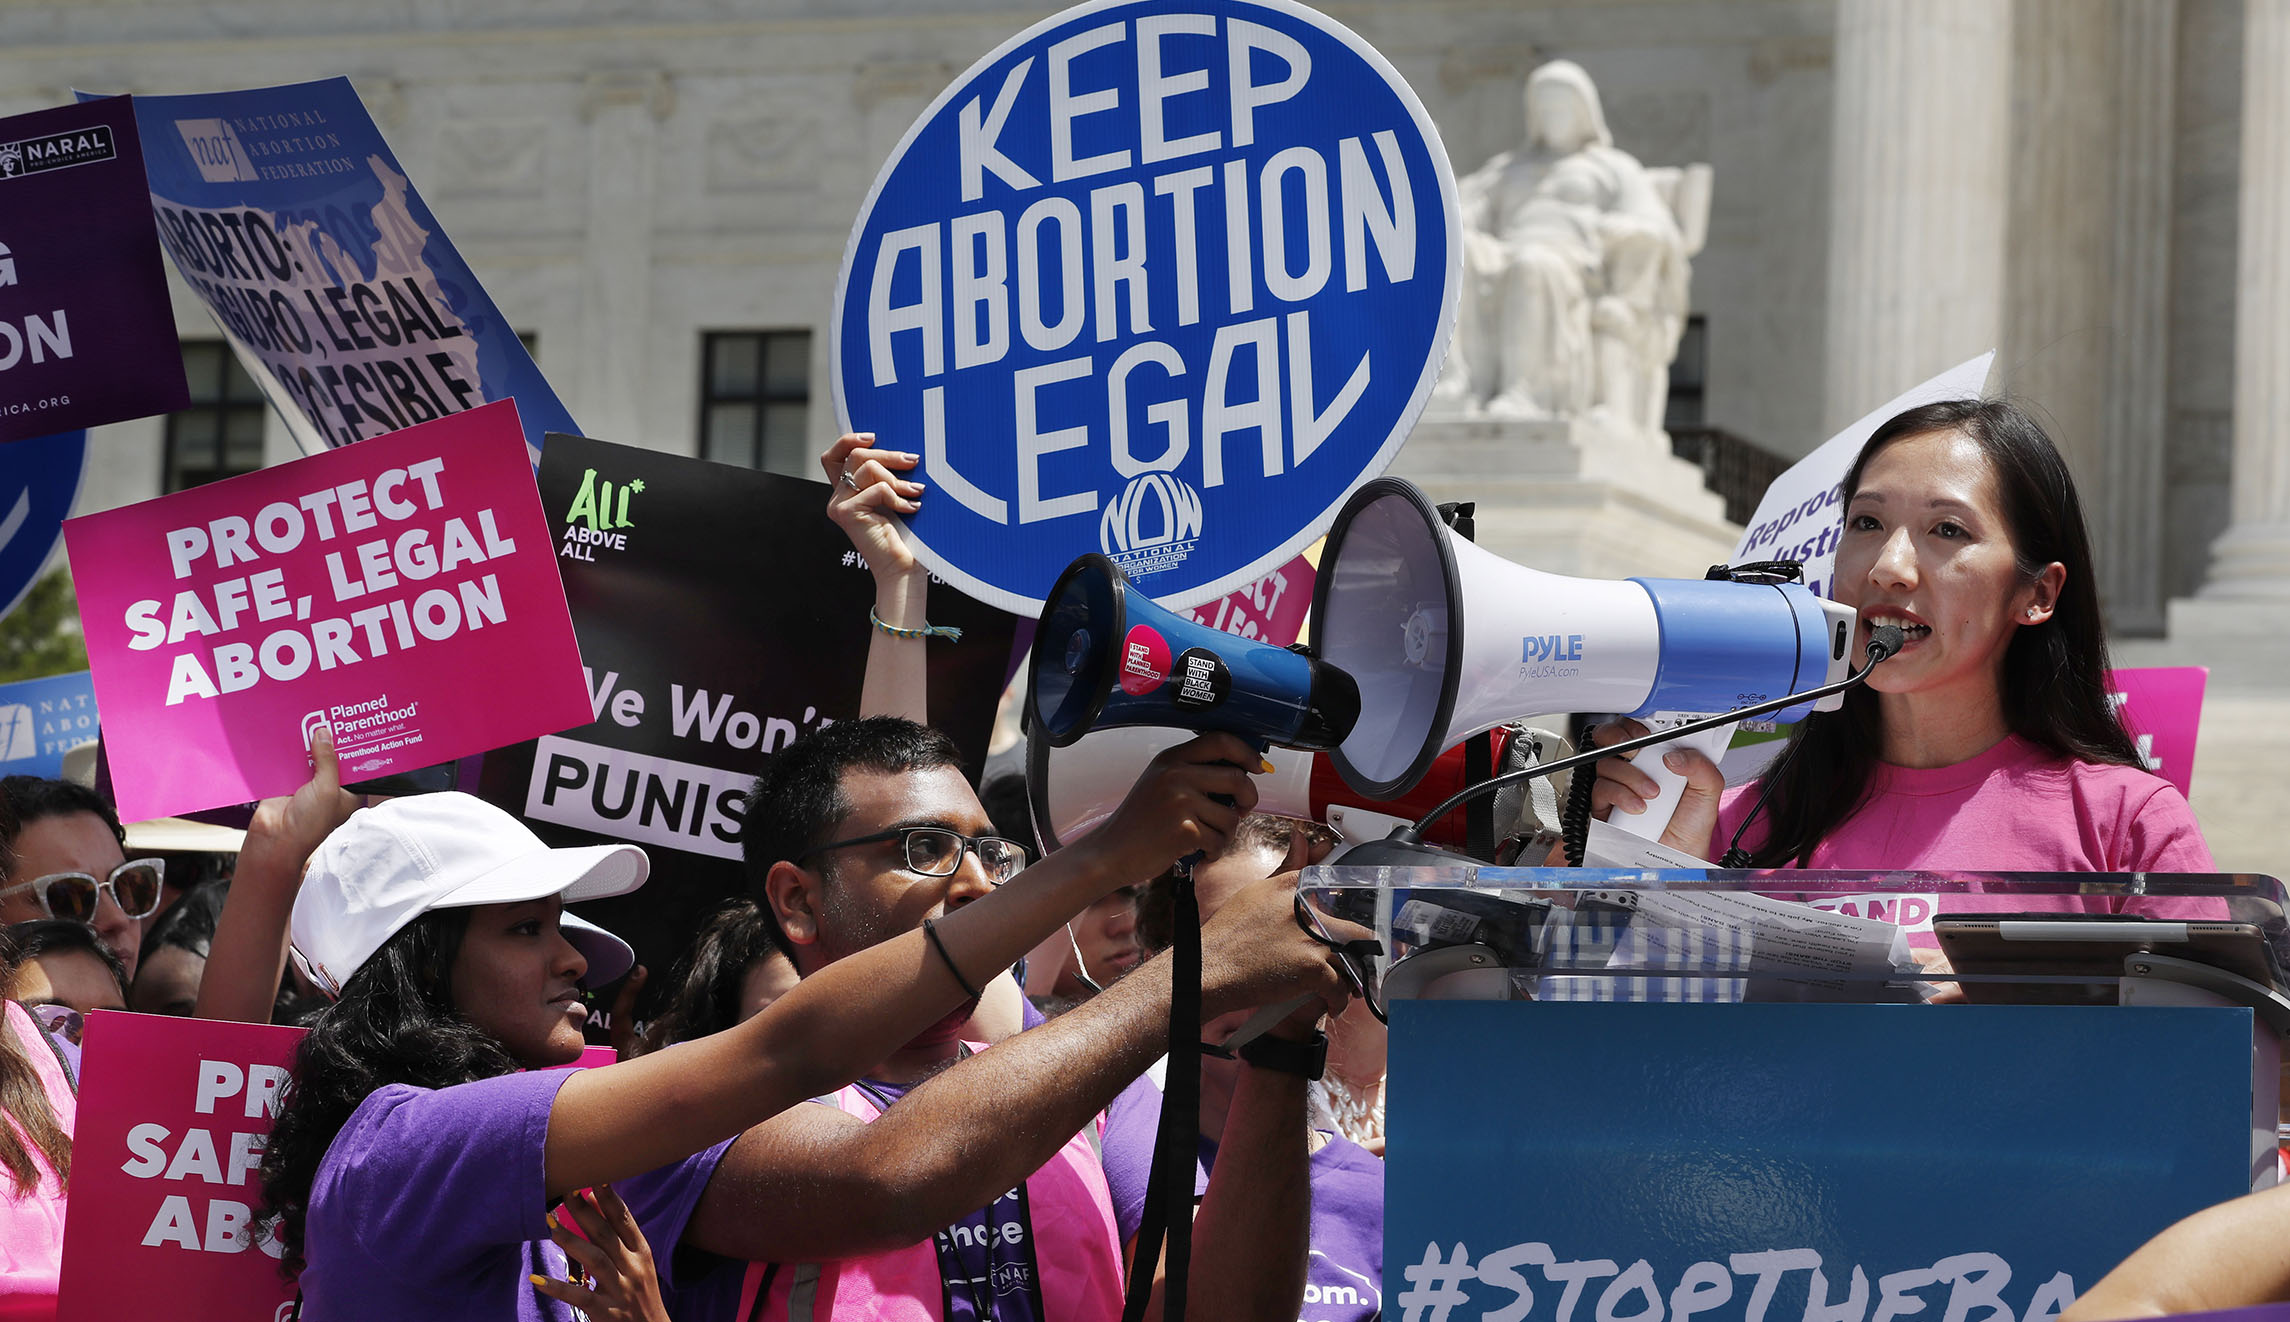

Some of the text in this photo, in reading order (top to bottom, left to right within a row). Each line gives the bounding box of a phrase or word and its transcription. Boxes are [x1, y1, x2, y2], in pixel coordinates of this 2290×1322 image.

[960, 14, 1312, 202] KEEP
[234, 110, 326, 133] NATIONAL
[27, 133, 105, 160] NARAL
[249, 133, 341, 157] ABORTION
[260, 157, 355, 180] FEDERATION
[150, 205, 304, 282] ABORTO:
[869, 130, 1416, 387] ABORTION
[303, 277, 462, 351] LEGAL
[0, 396, 70, 417] ICA.ORG
[923, 311, 1370, 526] LEGAL
[166, 457, 445, 579] PROTECT
[1100, 474, 1203, 554] NOW
[564, 526, 627, 551] ABOVE
[560, 542, 596, 562] ALL
[1110, 543, 1195, 563] NATIONAL
[125, 509, 517, 651] SAFE, LEGAL
[1128, 562, 1178, 576] FOR WOMEN
[165, 574, 507, 706] ABORTION
[1133, 644, 1149, 654] STAND
[1522, 635, 1583, 663] PYLE
[1130, 651, 1143, 660] WITH
[1189, 658, 1214, 670] STAND
[1126, 664, 1160, 679] PARENTHOOD
[1188, 667, 1208, 680] WITH
[1519, 665, 1579, 680] PyleUSA.com
[1182, 687, 1214, 701] WOMEN
[1185, 678, 1210, 691] BLACK
[331, 694, 388, 720] Planned
[334, 703, 417, 735] Parenthood
[42, 715, 100, 735] ABO
[337, 735, 353, 745] Act.
[365, 727, 387, 738] matter
[339, 734, 422, 760] Parenthood Action Fund
[542, 753, 745, 843] PUNIS
[1732, 900, 1750, 908] care
[195, 1059, 294, 1119] PR
[121, 1122, 269, 1186] SAF
